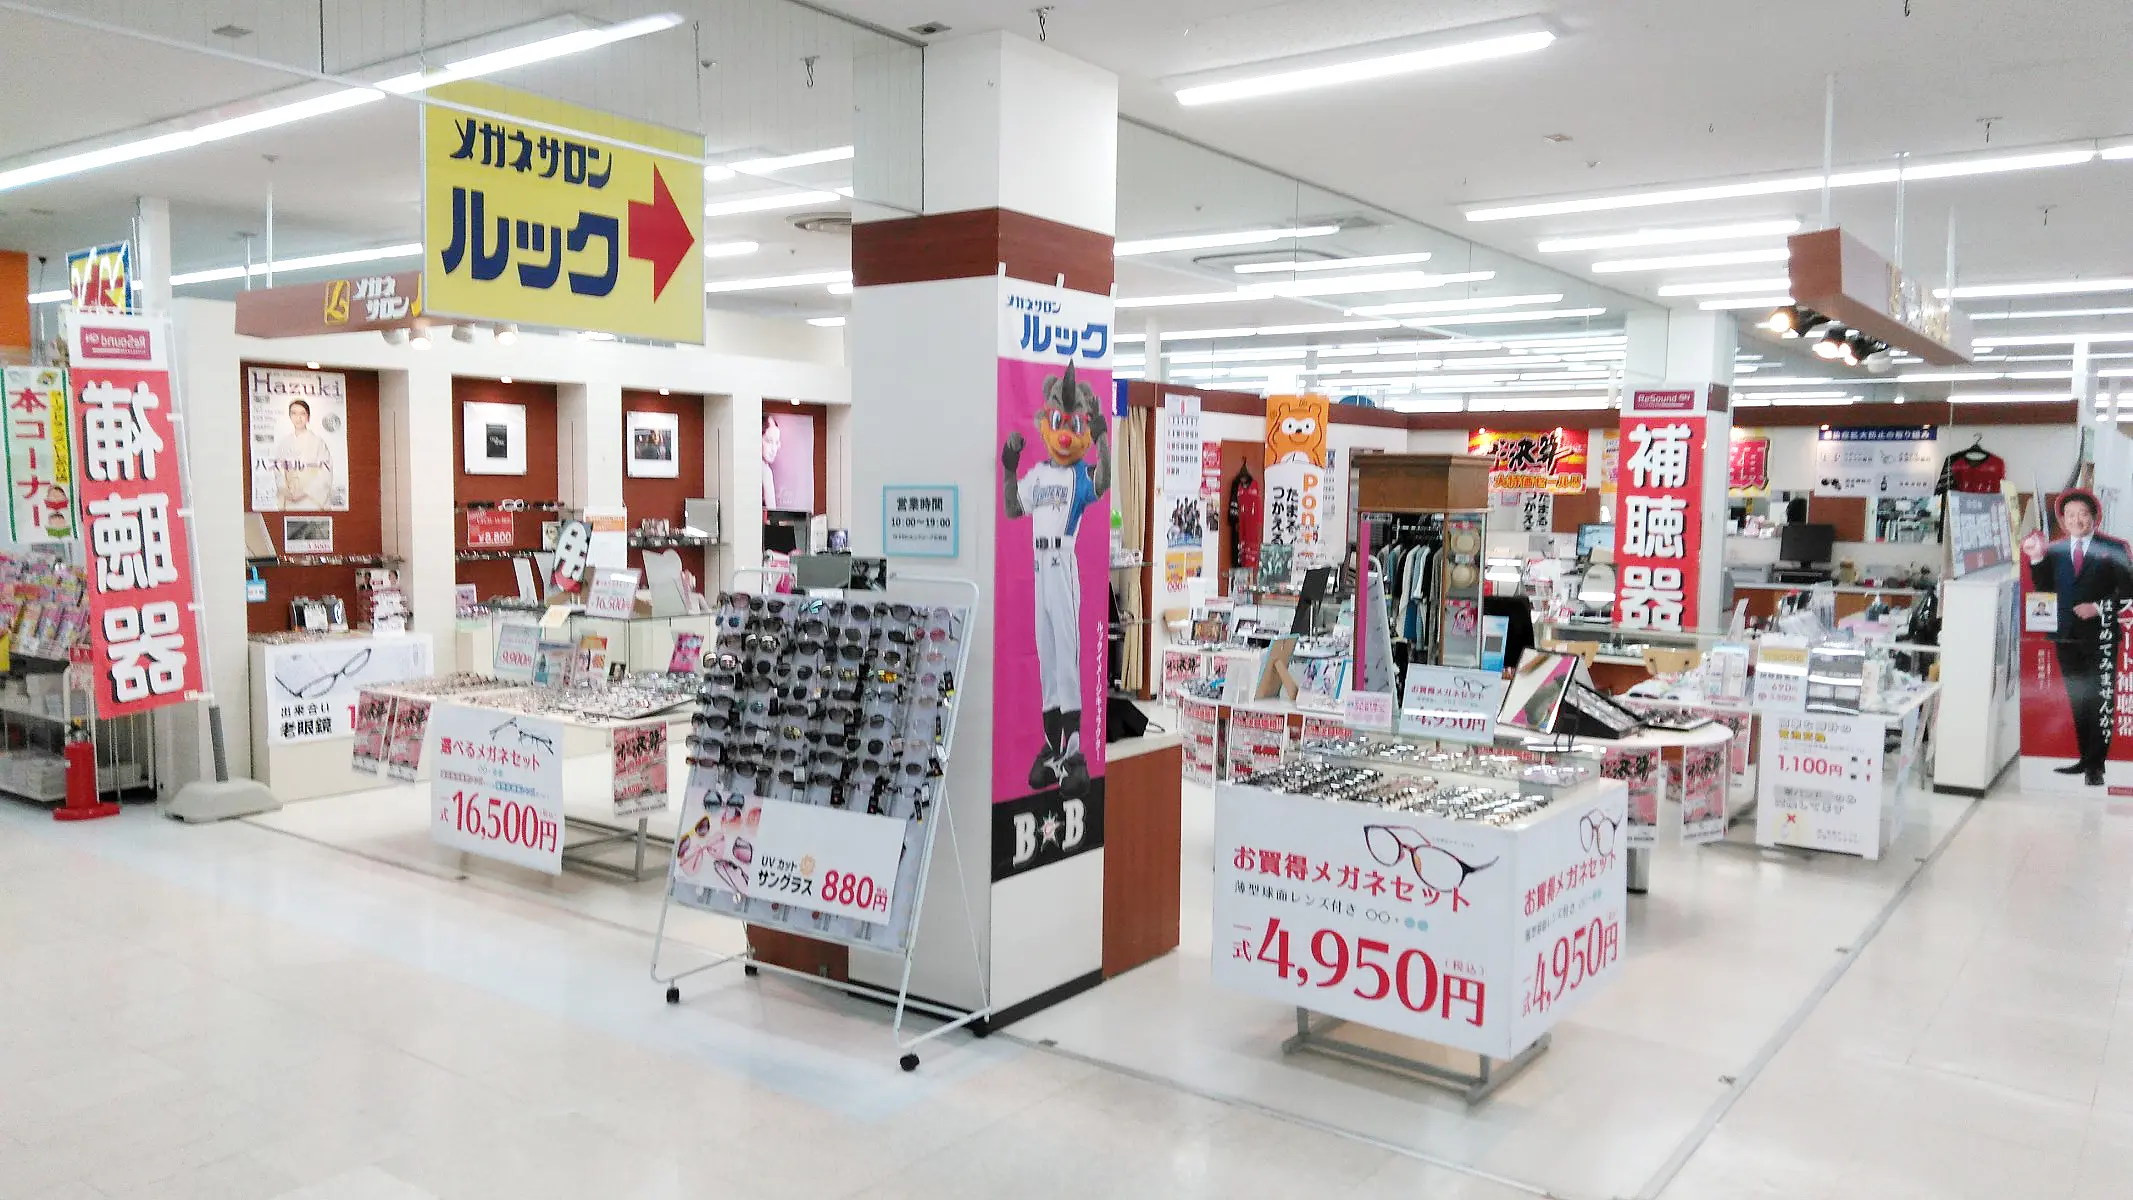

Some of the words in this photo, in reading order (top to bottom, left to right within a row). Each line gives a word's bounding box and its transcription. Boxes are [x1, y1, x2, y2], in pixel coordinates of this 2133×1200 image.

[450, 119, 612, 188] メガネサロン
[441, 186, 619, 297] ルック
[352, 275, 396, 301] メガネ
[366, 296, 409, 322] サロン
[1006, 294, 1062, 314] メガネサロン
[1020, 314, 1107, 359] ルック
[253, 372, 341, 397] Hazuki
[9, 387, 50, 528] 本コーナー
[897, 496, 943, 512] 営業時間
[1619, 423, 1693, 632] 補聴器
[281, 717, 332, 738] 老眼鏡
[440, 736, 541, 773] 選べるメガネセット
[1778, 754, 1843, 777] 1,100円
[452, 789, 557, 854] 16,500円
[758, 869, 813, 896] サングラス
[821, 869, 888, 912] 880円
[1233, 845, 1471, 912] お買得メガネセット
[1234, 879, 1356, 917] 薄型球面レンズ付き
[1524, 850, 1616, 917] お買得メガネセット
[1256, 917, 1485, 1028] 4,950円
[1533, 916, 1618, 1013] 4,950円
